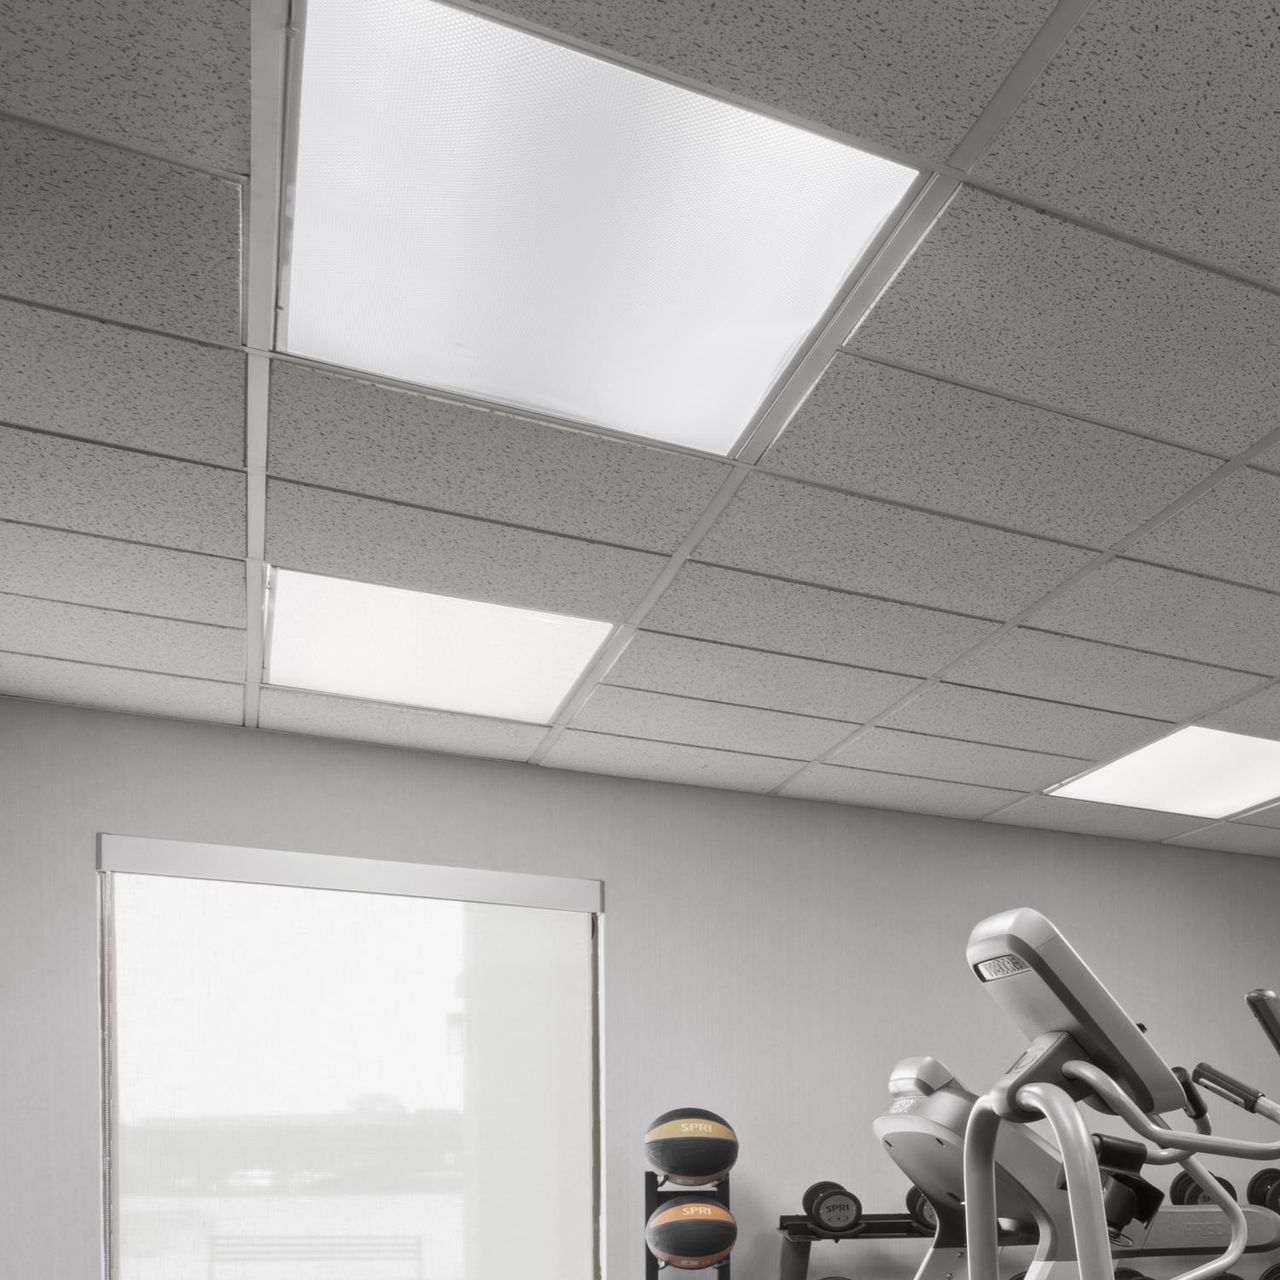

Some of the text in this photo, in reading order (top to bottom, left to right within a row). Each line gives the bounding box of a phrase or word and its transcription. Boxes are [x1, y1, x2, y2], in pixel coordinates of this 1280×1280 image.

[680, 1122, 713, 1133] SPRI
[681, 1206, 712, 1216] SPRI
[825, 1203, 850, 1213] SPRI
